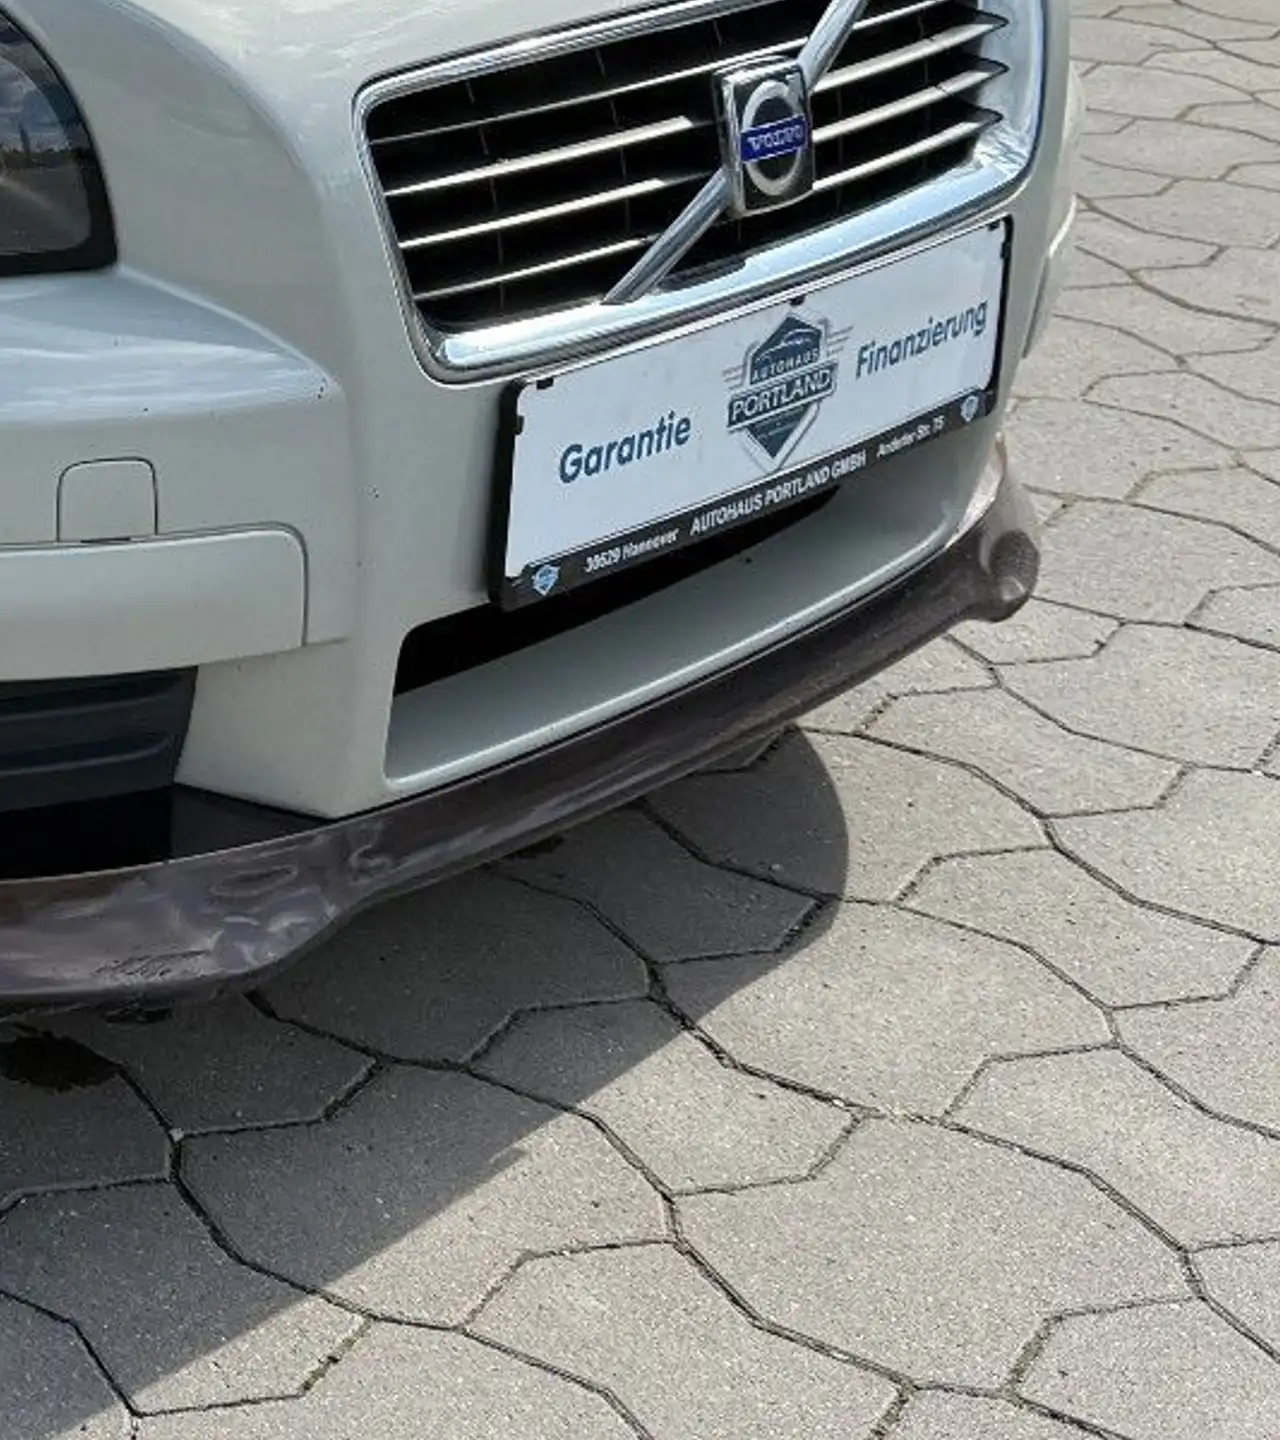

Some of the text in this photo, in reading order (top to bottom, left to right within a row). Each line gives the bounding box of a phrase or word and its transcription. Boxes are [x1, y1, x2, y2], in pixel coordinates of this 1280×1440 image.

[747, 124, 804, 151] VOLVO
[751, 347, 820, 383] AUTOHAUS
[855, 300, 989, 380] Finanzierung
[731, 369, 831, 422] PORTLAND
[559, 410, 691, 484] Garantie
[689, 493, 763, 537] AUTOHAUS
[764, 466, 830, 507] PORTLAND
[831, 449, 867, 479] GMBH
